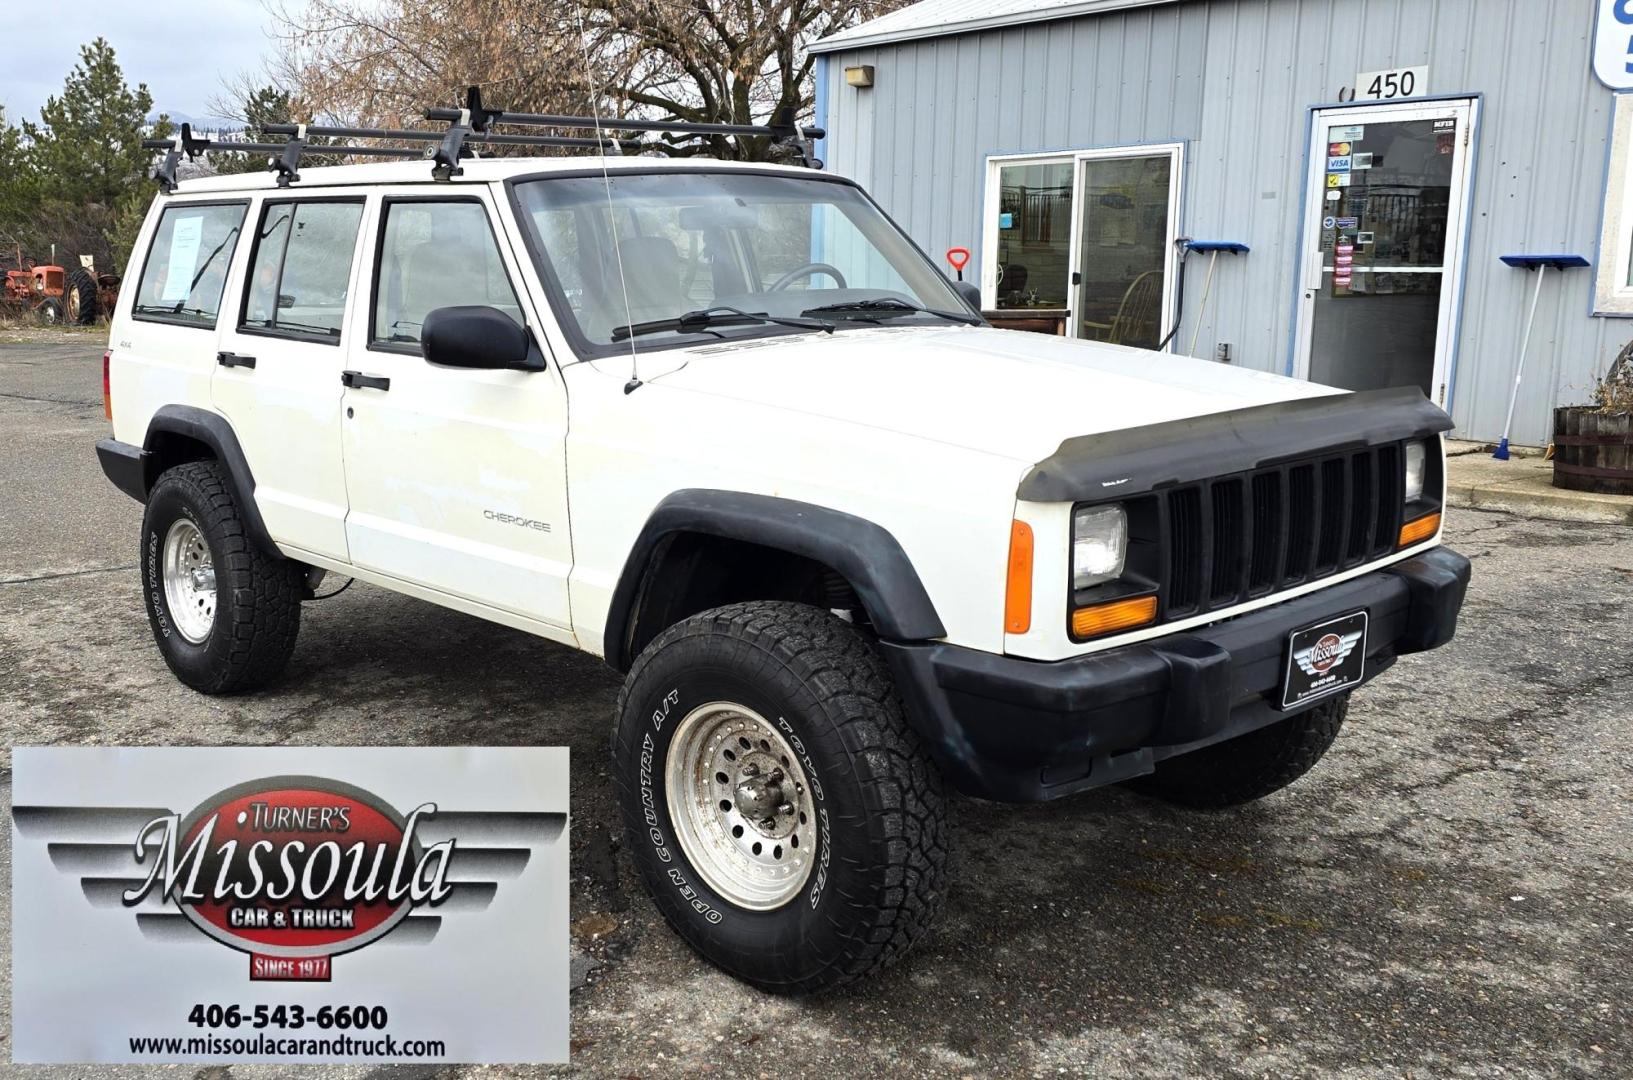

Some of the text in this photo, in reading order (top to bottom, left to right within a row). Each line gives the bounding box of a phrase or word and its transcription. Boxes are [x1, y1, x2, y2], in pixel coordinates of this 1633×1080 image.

[1367, 70, 1415, 99] 450
[1331, 159, 1349, 167] VISA
[483, 509, 552, 533] CHEROKEE
[640, 689, 723, 924] OPEN COUNTRY A/T
[779, 716, 831, 910] TOYO TIRES
